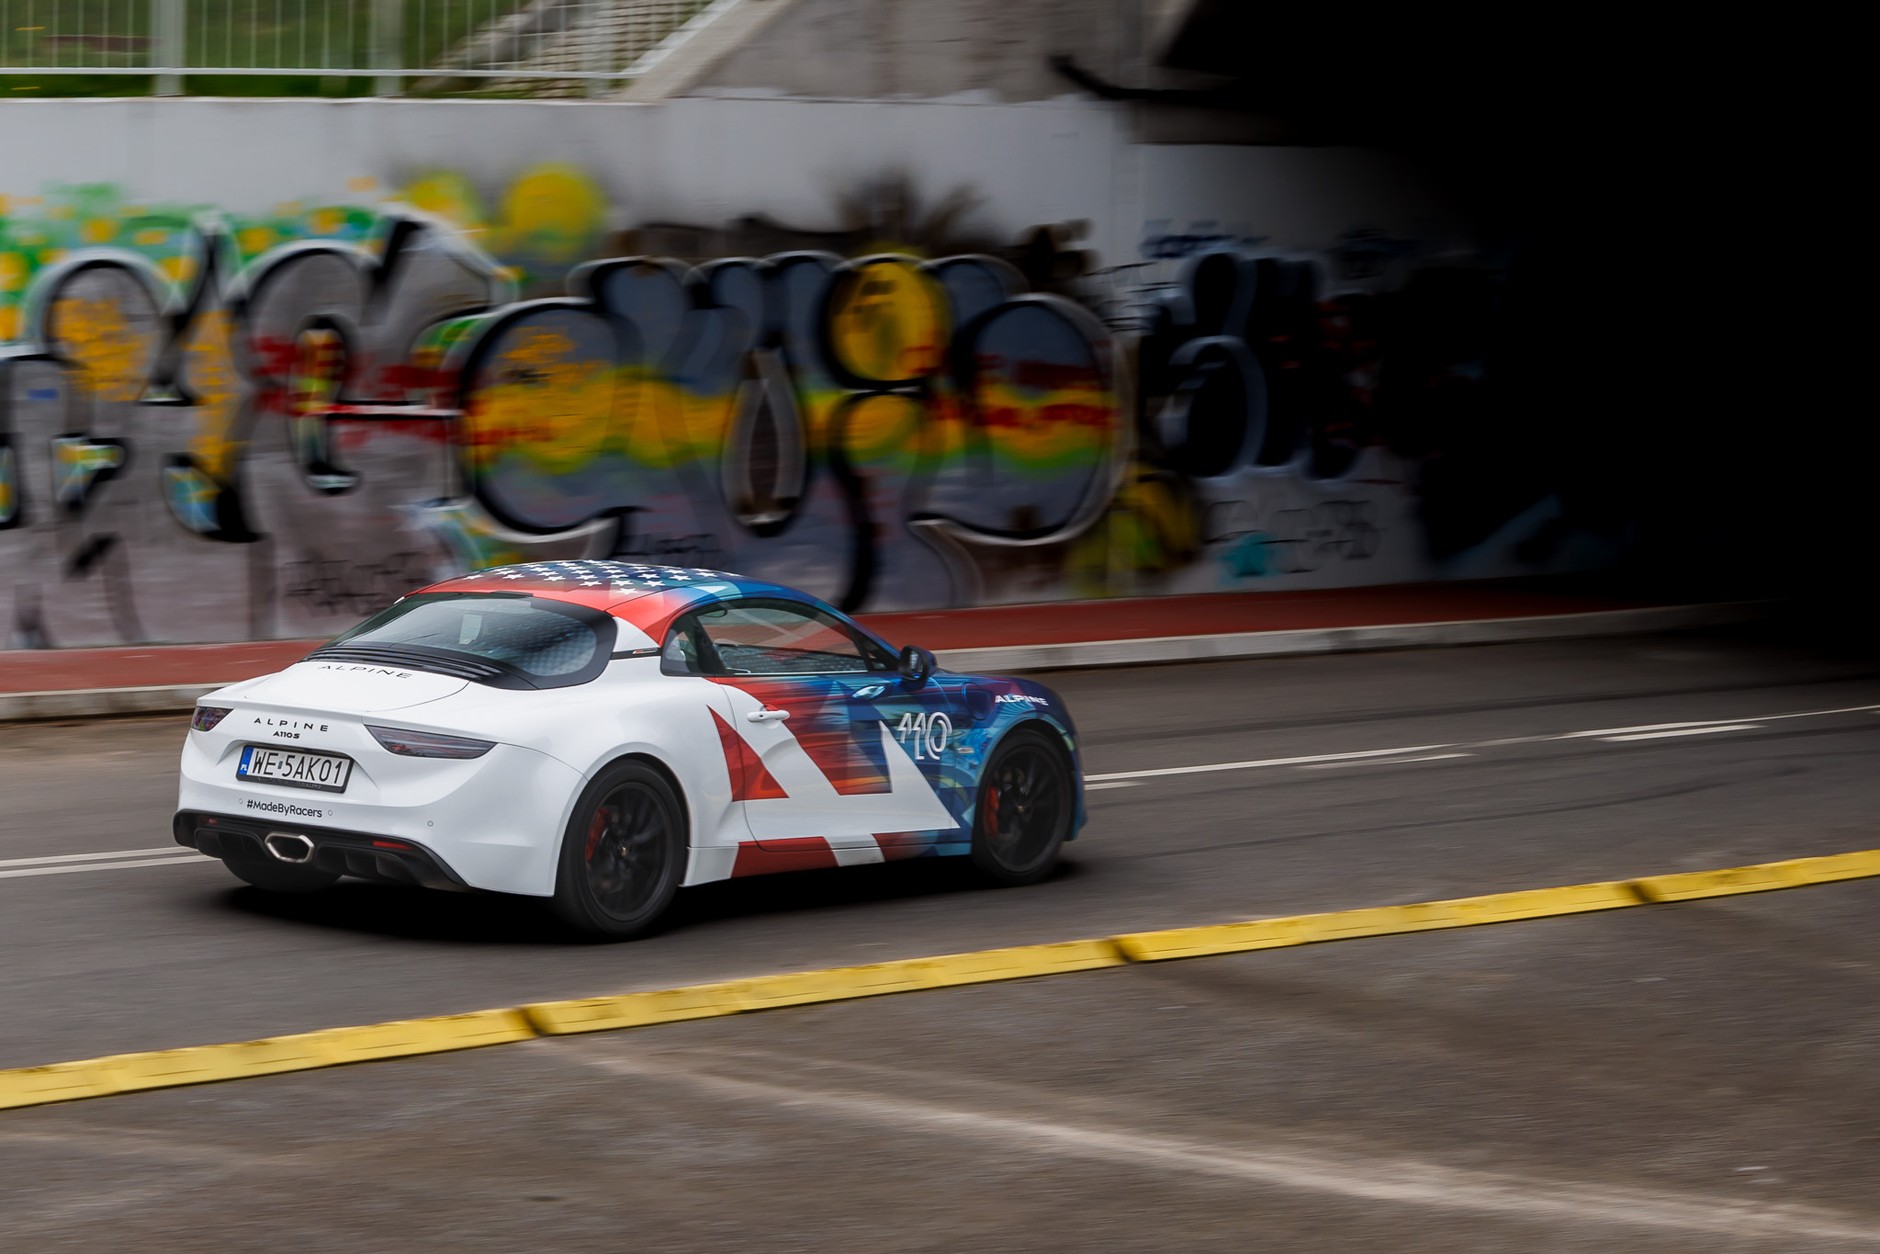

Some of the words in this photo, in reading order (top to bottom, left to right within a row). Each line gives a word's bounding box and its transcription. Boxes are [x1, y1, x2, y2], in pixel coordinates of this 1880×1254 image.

[318, 665, 413, 679] ALPINE
[995, 694, 1049, 706] ALPINE
[253, 717, 329, 732] ALPINE
[251, 751, 279, 776] WE
[281, 754, 343, 785] 5AK01
[246, 799, 323, 818] #MadeByRacers
